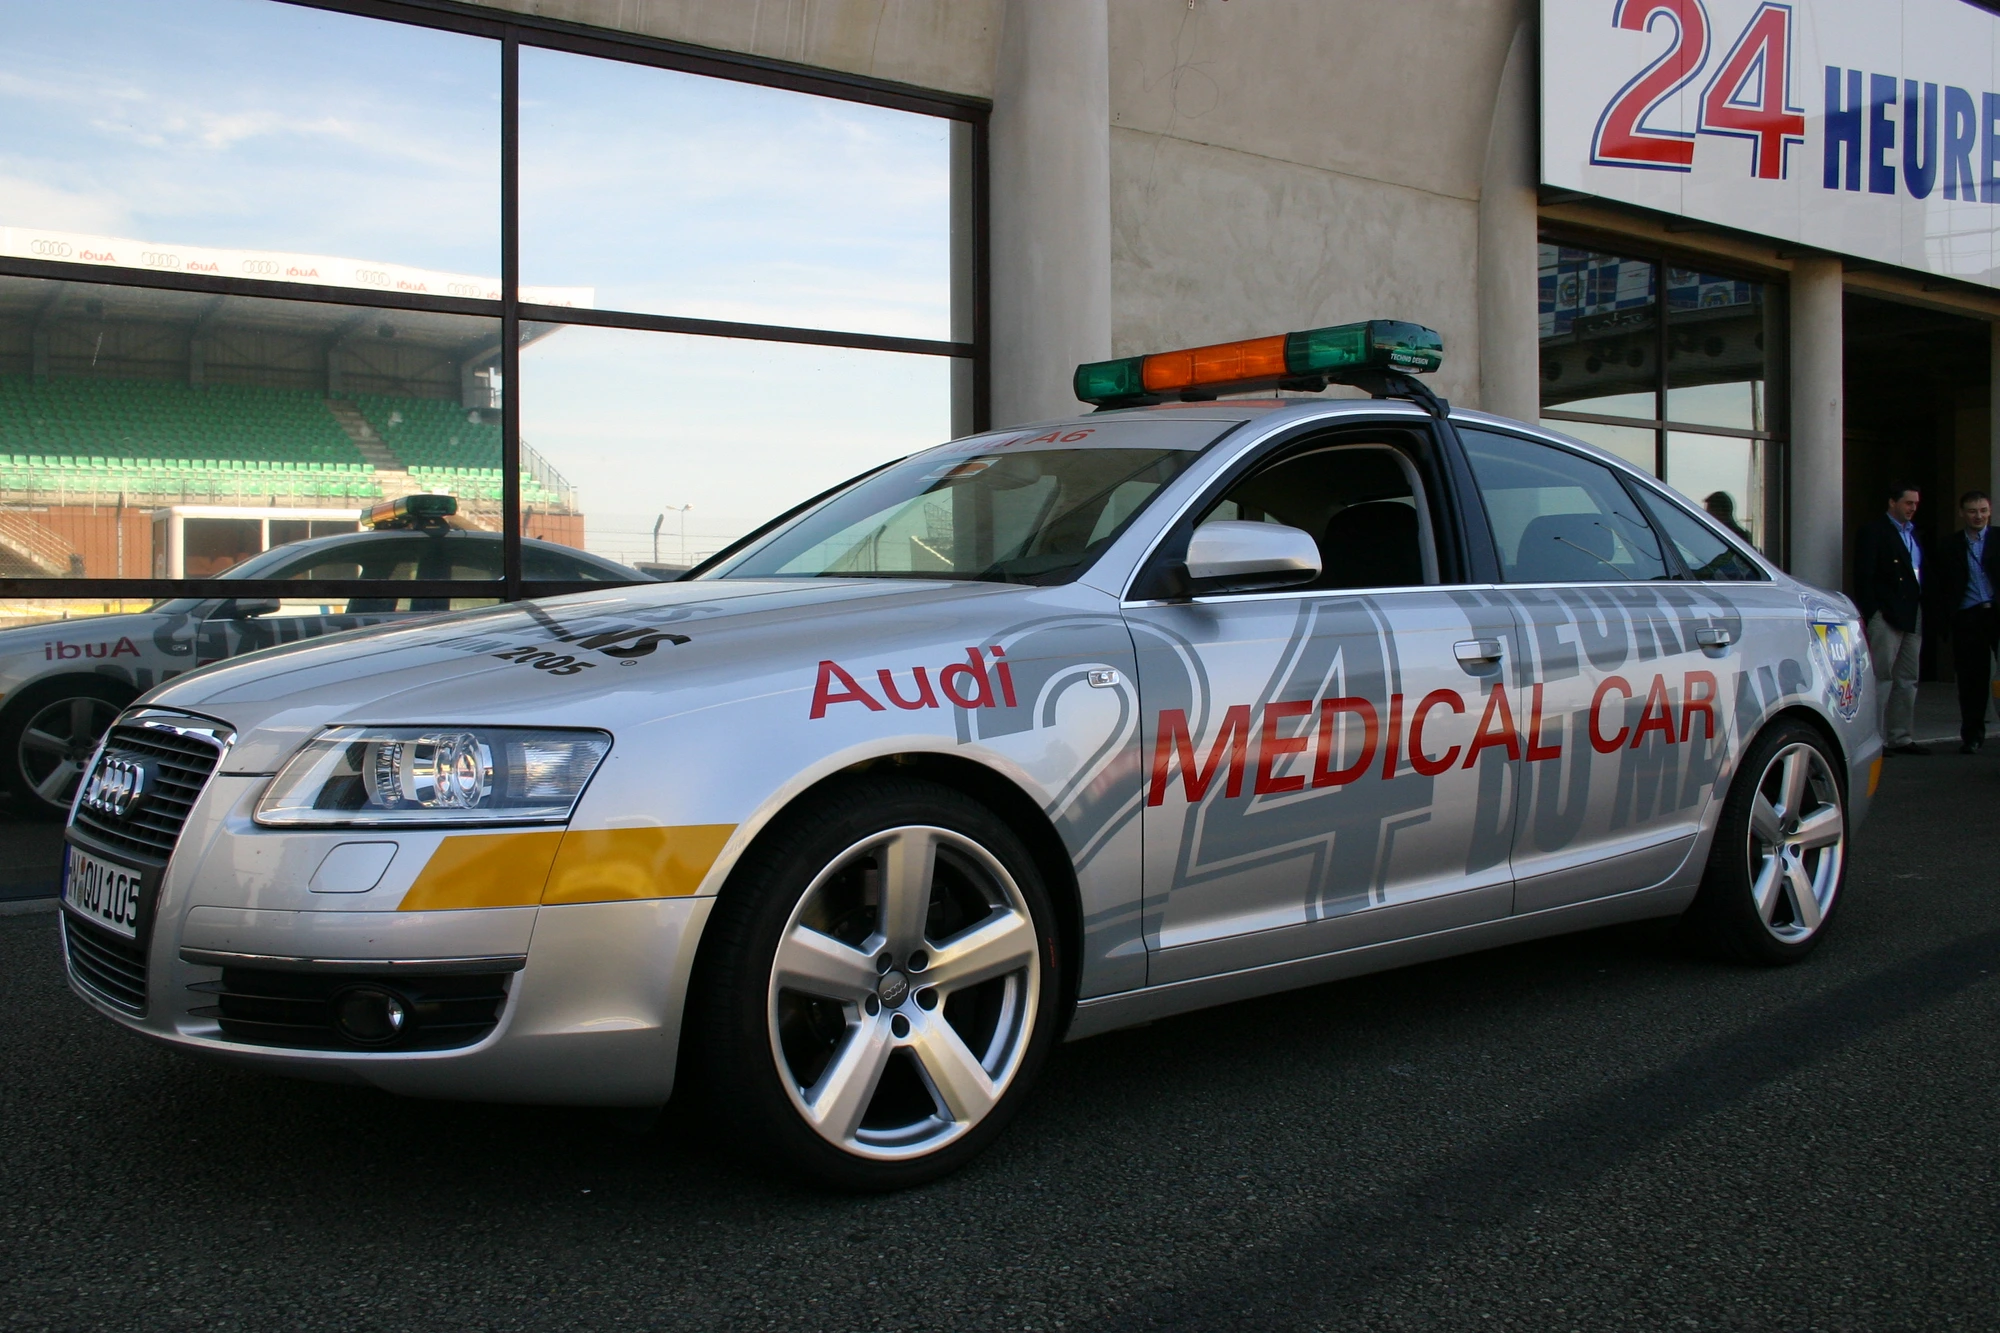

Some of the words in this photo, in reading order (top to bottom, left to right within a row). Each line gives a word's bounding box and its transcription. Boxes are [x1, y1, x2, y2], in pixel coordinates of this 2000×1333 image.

[1589, 0, 1805, 180] 24
[1390, 353, 1412, 362] TECHNO
[1411, 356, 1429, 366] DESIGN
[1024, 429, 1096, 445] A6
[491, 646, 598, 676] 2005
[809, 645, 1018, 720] Audi
[1839, 683, 1853, 707] 24
[1146, 682, 1562, 808] MEDICAL
[1588, 670, 1717, 755] CAR
[84, 861, 104, 913] QU
[103, 869, 141, 928] 105
